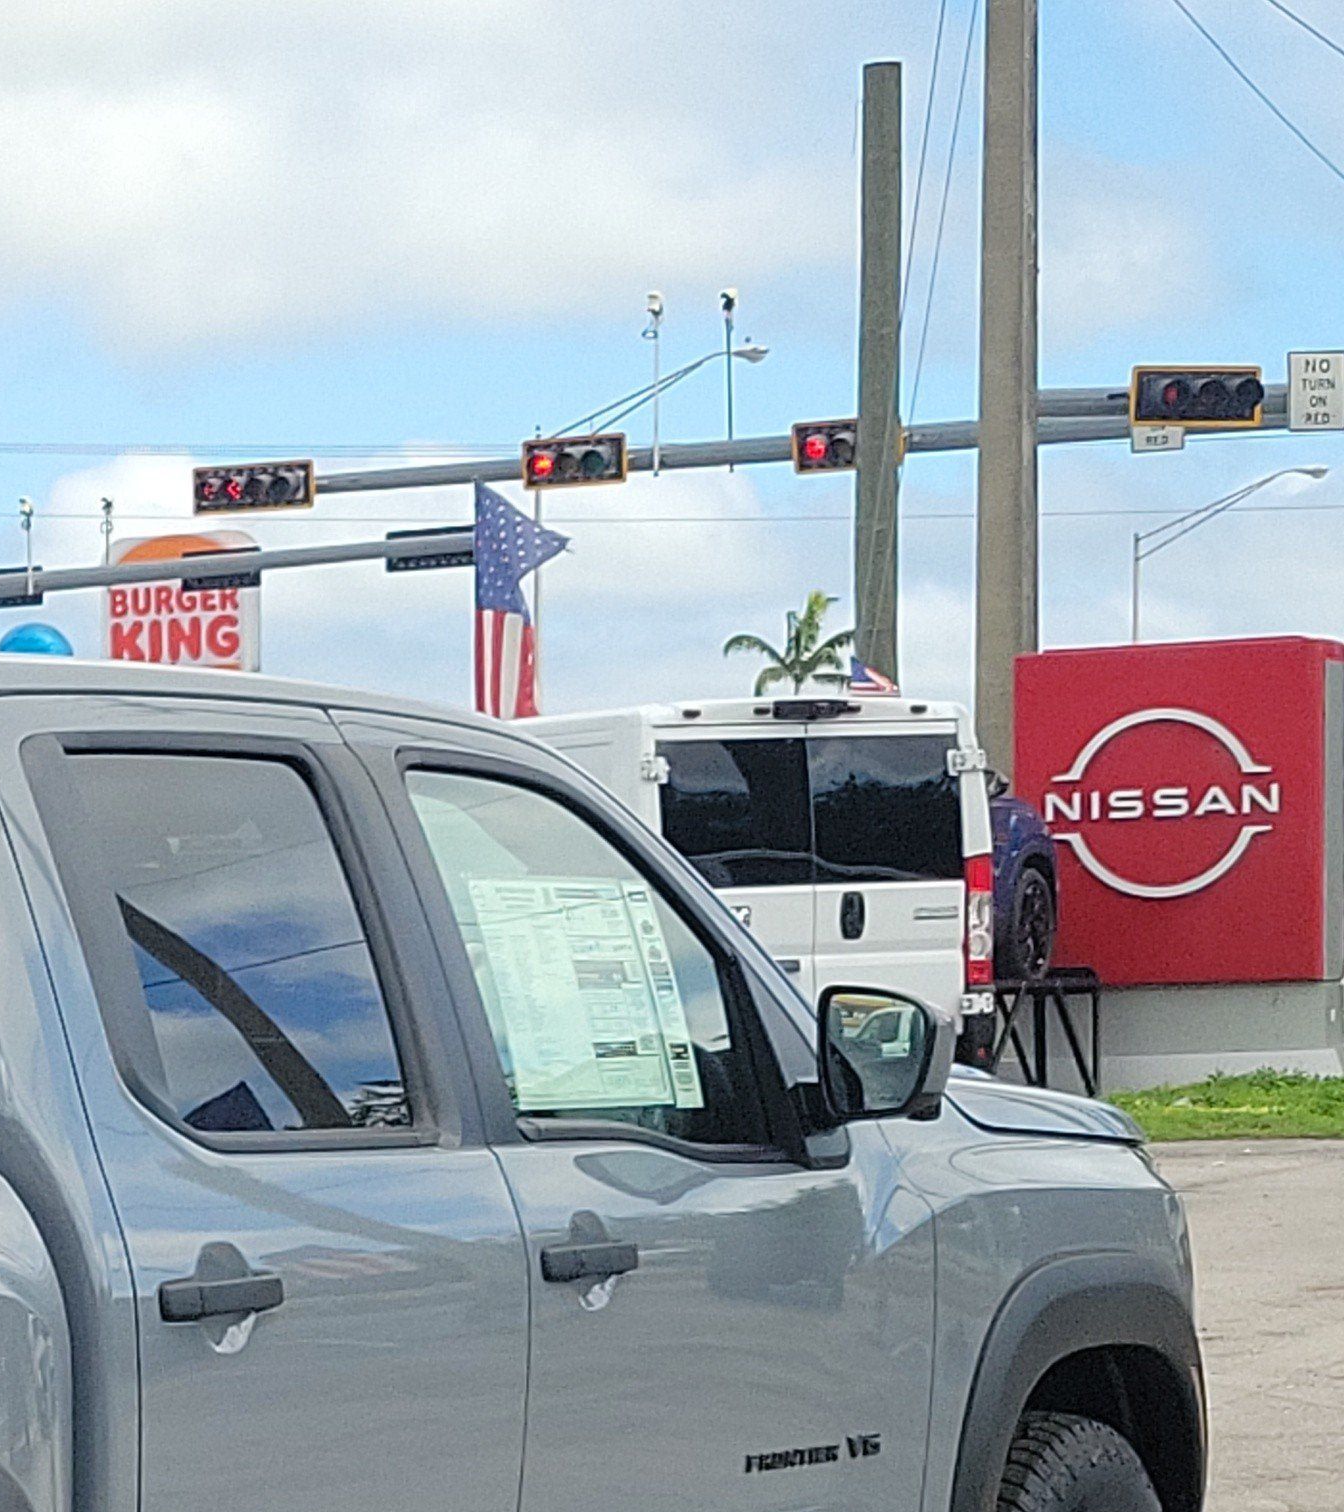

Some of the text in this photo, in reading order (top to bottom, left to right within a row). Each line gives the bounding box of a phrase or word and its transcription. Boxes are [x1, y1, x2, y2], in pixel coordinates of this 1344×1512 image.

[1304, 358, 1330, 374] NO
[1301, 378, 1336, 392] TURN
[1309, 395, 1328, 407] ON
[1304, 412, 1331, 425] RED
[1145, 435, 1168, 446] RED
[108, 585, 240, 618] BURGER
[110, 614, 240, 663] KING
[1045, 781, 1283, 825] NISSAN
[744, 1432, 883, 1473] FRONTIER V6
